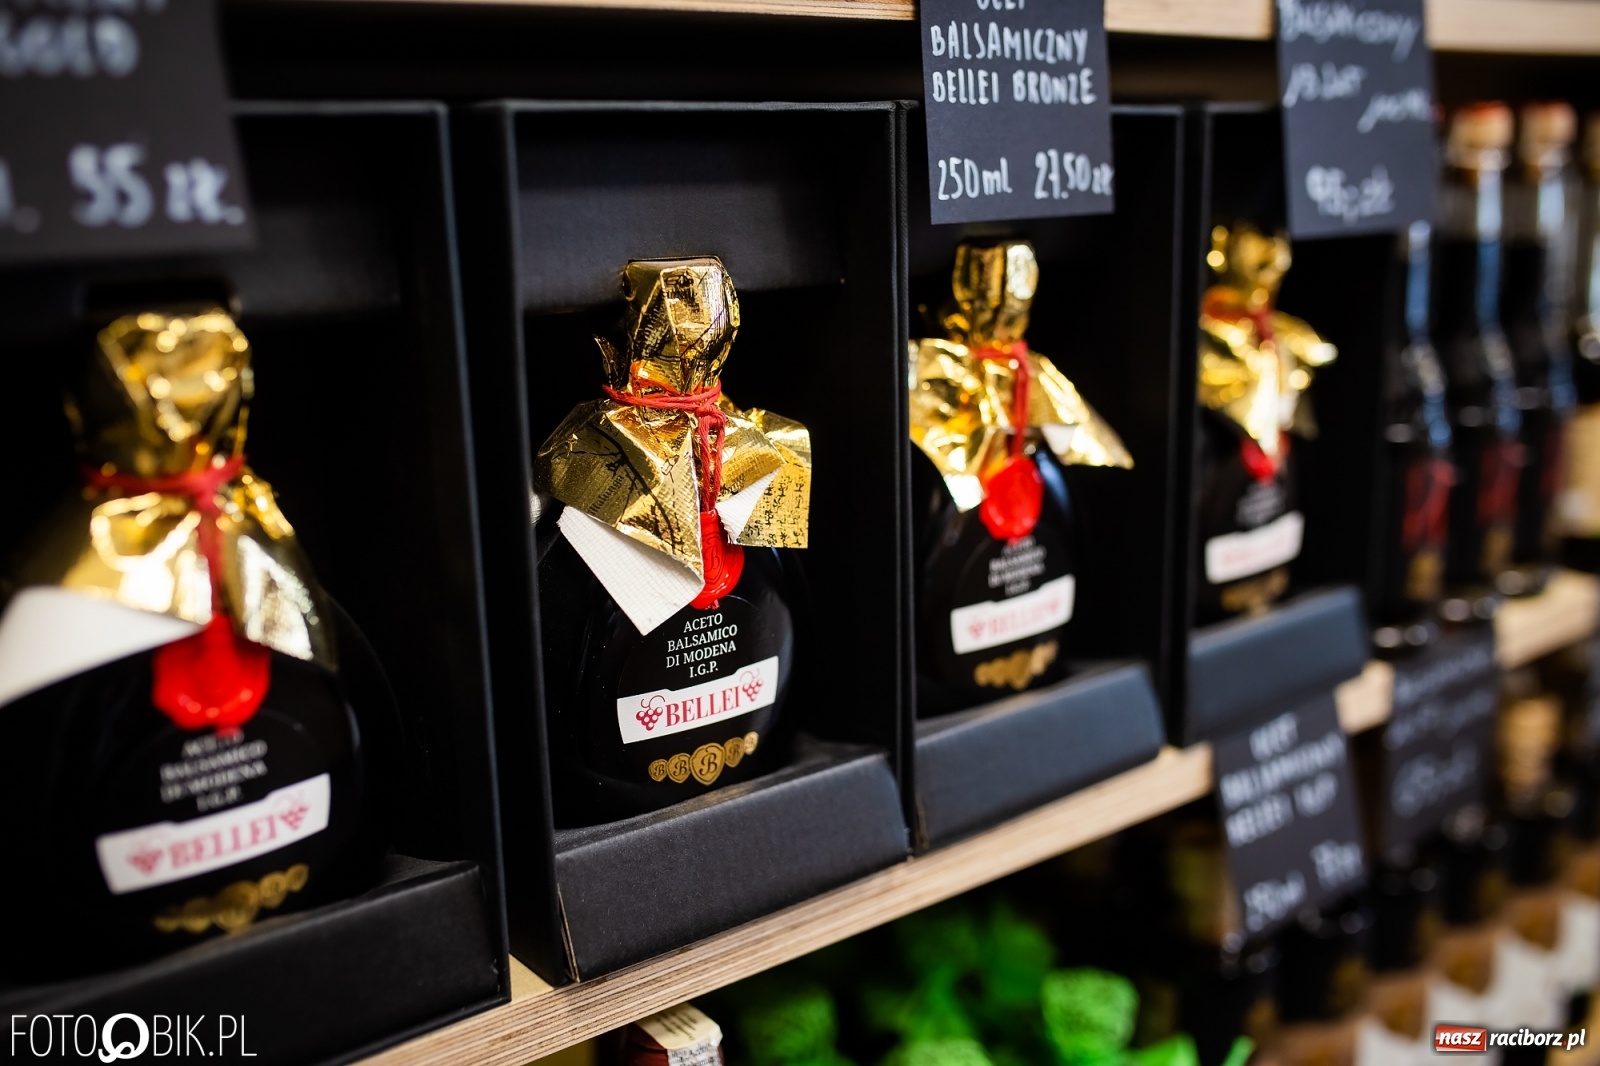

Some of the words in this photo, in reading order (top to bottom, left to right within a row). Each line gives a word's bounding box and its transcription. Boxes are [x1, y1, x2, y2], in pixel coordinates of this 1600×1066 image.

[930, 20, 1088, 66] BALSAMICZNY
[932, 68, 1000, 105] BELLEI
[1012, 67, 1097, 105] BRONZE
[69, 142, 153, 228] 55
[938, 156, 1013, 201] 250ml
[667, 624, 738, 653] BALSAMICO
[683, 612, 723, 634] ACETO
[666, 655, 680, 668] DI
[683, 640, 737, 665] MODENA
[689, 660, 719, 678] I.G.P.
[665, 686, 742, 727] BELLEI
[168, 814, 277, 870] BELLEI
